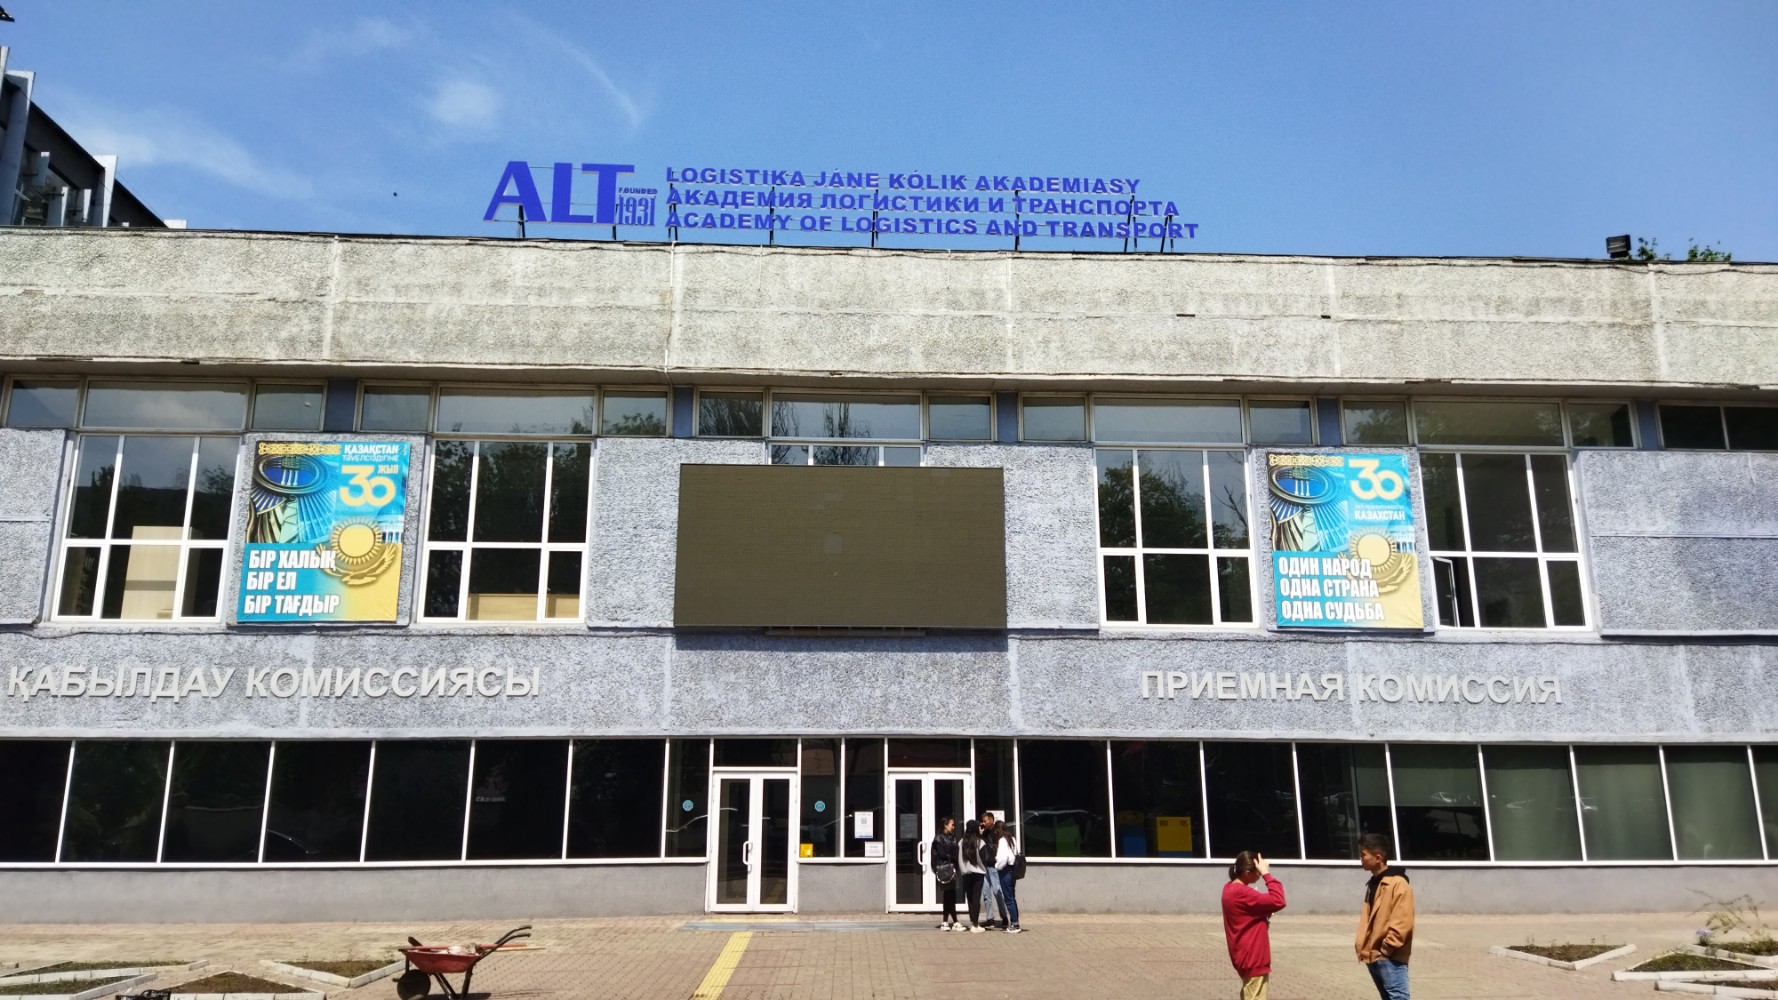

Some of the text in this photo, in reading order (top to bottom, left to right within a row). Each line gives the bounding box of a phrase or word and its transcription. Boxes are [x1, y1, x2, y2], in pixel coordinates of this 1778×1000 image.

[483, 161, 635, 225] ALT
[618, 187, 658, 195] FOUNDED
[666, 167, 806, 186] LOGISTIKA
[975, 175, 1141, 194] AKADEMIASY
[618, 196, 656, 226] 1931
[666, 189, 1180, 216] АКАДЕМИЯ ЛОГИСТИКИ И ТРАНСПОРТА
[665, 212, 1199, 239] ACADEMY OF LOGISTICS AND TRANSPORT
[344, 444, 399, 456] ҚАЗАҚСТАН
[339, 465, 397, 507] 30
[1349, 458, 1405, 501] 30
[1354, 510, 1406, 521] КАЗАХСТАН
[248, 549, 337, 572] БІР ХАЛЫҚ
[1278, 556, 1373, 579] ОДИН НАРОД
[246, 571, 297, 590] БІР ЕЛ
[1280, 577, 1380, 599] ОДНА СТРАНА
[243, 595, 340, 617] БІР ТАҒДЫР
[1281, 600, 1385, 623] ОДНА СУДЬБА
[7, 665, 541, 703] ҚАБЫЛДАУ КОМИССИЯСЫ
[1140, 671, 1563, 704] ПРИЕМНАЯ КОМИССИЯ
